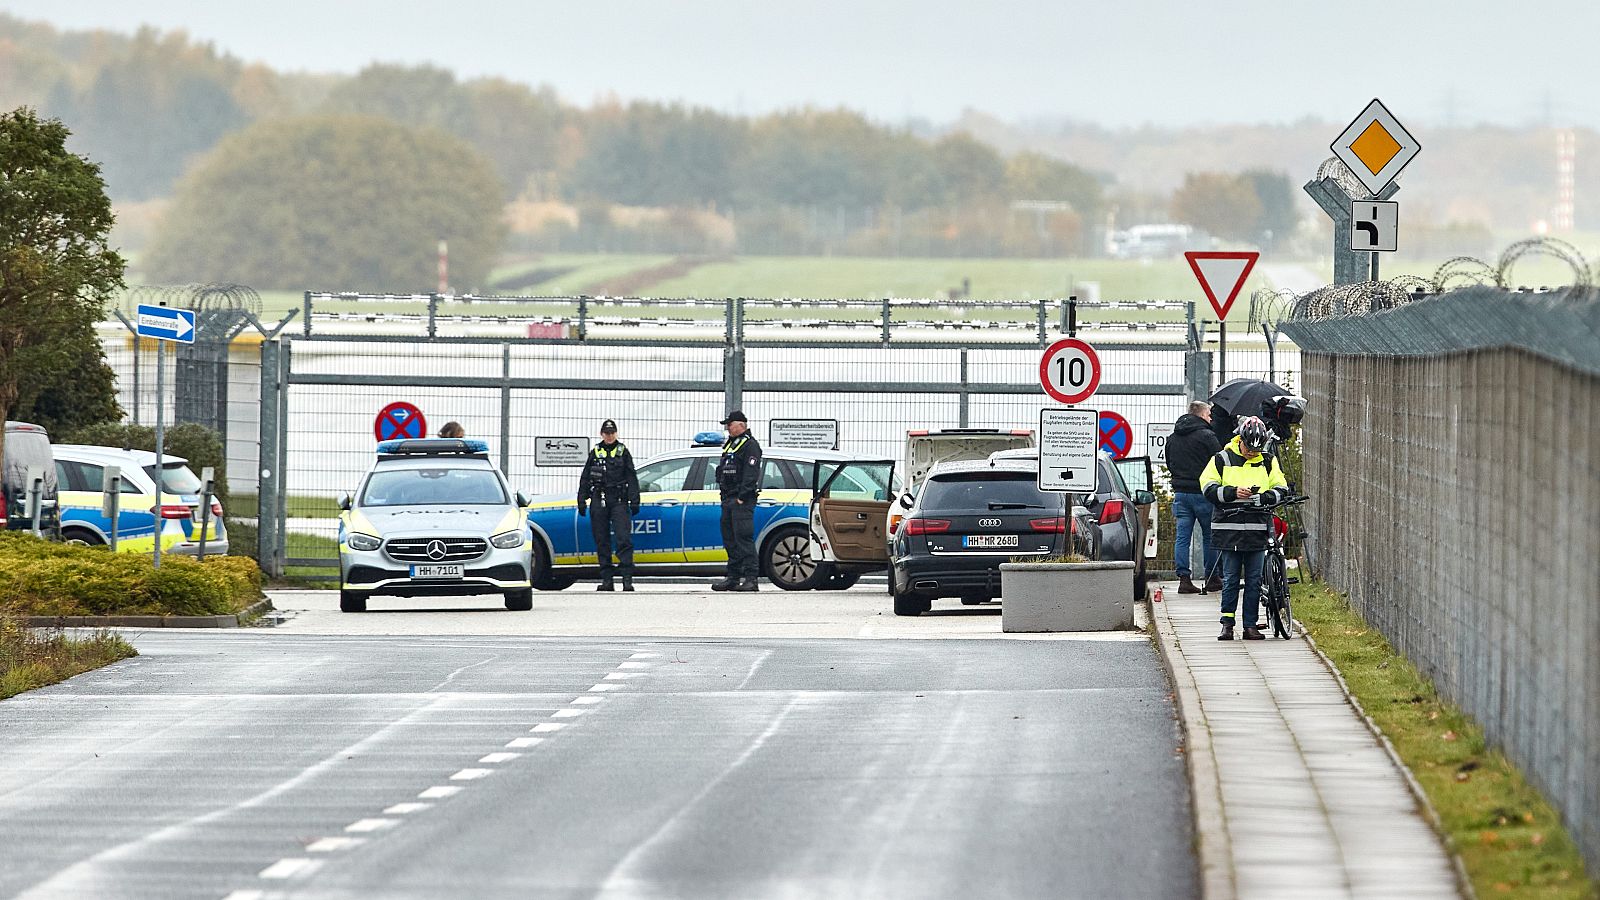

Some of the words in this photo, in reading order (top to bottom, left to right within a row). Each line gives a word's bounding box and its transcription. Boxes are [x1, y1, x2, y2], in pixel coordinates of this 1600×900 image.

[1057, 358, 1085, 387] 10
[1149, 436, 1169, 446] TO
[1158, 450, 1164, 460] 4
[968, 536, 978, 545] HH
[996, 536, 1017, 545] 2680
[420, 566, 431, 575] HH
[437, 566, 459, 575] 7101
